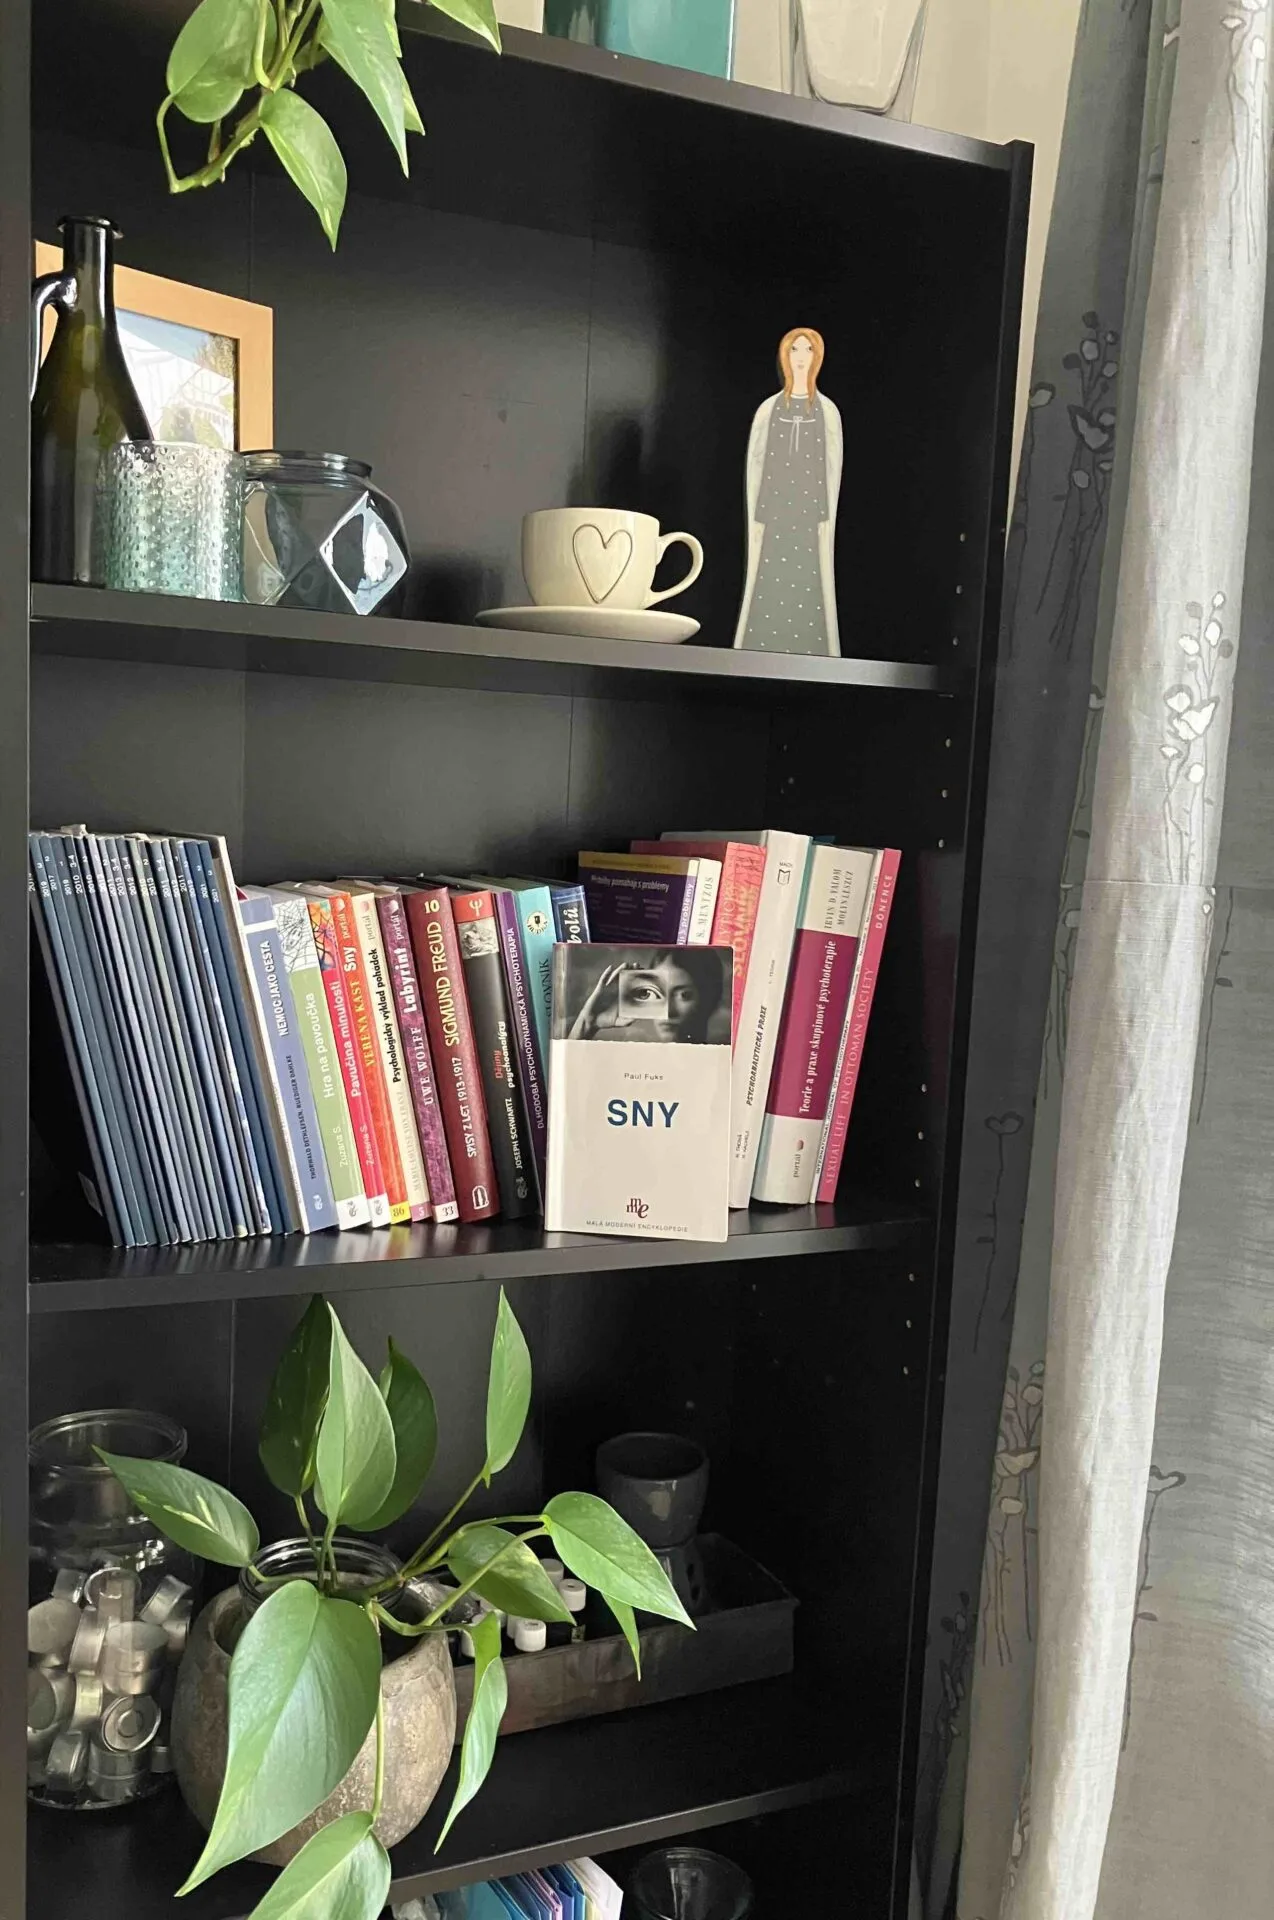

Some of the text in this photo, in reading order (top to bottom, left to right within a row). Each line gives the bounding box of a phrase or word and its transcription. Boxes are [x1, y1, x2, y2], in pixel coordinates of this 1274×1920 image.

[48, 874, 58, 891] 2017
[68, 854, 83, 894] 2010 3-4
[110, 858, 126, 896] 2013 3-4
[121, 856, 137, 896] 2012 3-4
[146, 877, 157, 896] 2013
[156, 858, 171, 898] 2011 3-4
[177, 874, 187, 893] 2011
[424, 899, 440, 915] 10
[698, 876, 715, 927] MENTZOS
[824, 900, 836, 929] IRVIN
[831, 868, 843, 893] YALOM
[340, 913, 352, 939] portál
[362, 912, 377, 941] portál
[390, 914, 405, 941] portál
[563, 907, 582, 944] bolů
[343, 946, 358, 972] Sny
[818, 940, 837, 1004] psychoterapie
[260, 940, 289, 1037] NEMOC JAKO CESTA
[393, 947, 418, 1014] Labyrint
[426, 921, 461, 1048] SIGMUND FREUD
[350, 982, 377, 1067] VERENA KAST
[368, 948, 402, 1083] Psychologický výklad pohádek
[506, 928, 545, 1129] DLHODOBÁ PSYCHODYNAMICKÁ PSYCHOTERAPIA
[812, 1003, 827, 1050] skupinové
[306, 993, 335, 1099] Hra na pavoučka
[330, 981, 362, 1098] Pavučina minulosti
[745, 1006, 768, 1107] PSYCHOANALYTICKÁ PRAXE
[410, 1028, 434, 1106] UWE WOLFF
[624, 1072, 664, 1081] Paul Fuks
[807, 1051, 819, 1078] praxe
[826, 968, 875, 1185] SEXUAL LIFE IN OTTOMAN SOCIETY
[451, 1056, 477, 1159] SPISY Z LET 1913-1917
[607, 1098, 680, 1128] SNY
[799, 1087, 814, 1114] Teorie
[336, 1136, 349, 1167] Zuzana
[361, 1133, 375, 1167] Zuzana
[504, 1097, 524, 1170] JOSEPH SCHWARTZ
[815, 1123, 830, 1174] INTERNATIONAL
[306, 1156, 317, 1180] THORWALD
[792, 1153, 802, 1179] portál
[392, 1205, 405, 1217] 86
[441, 1205, 454, 1216] 33
[586, 1219, 689, 1233] MALÁ MODERNÍ ENCYKLOPEDIE
